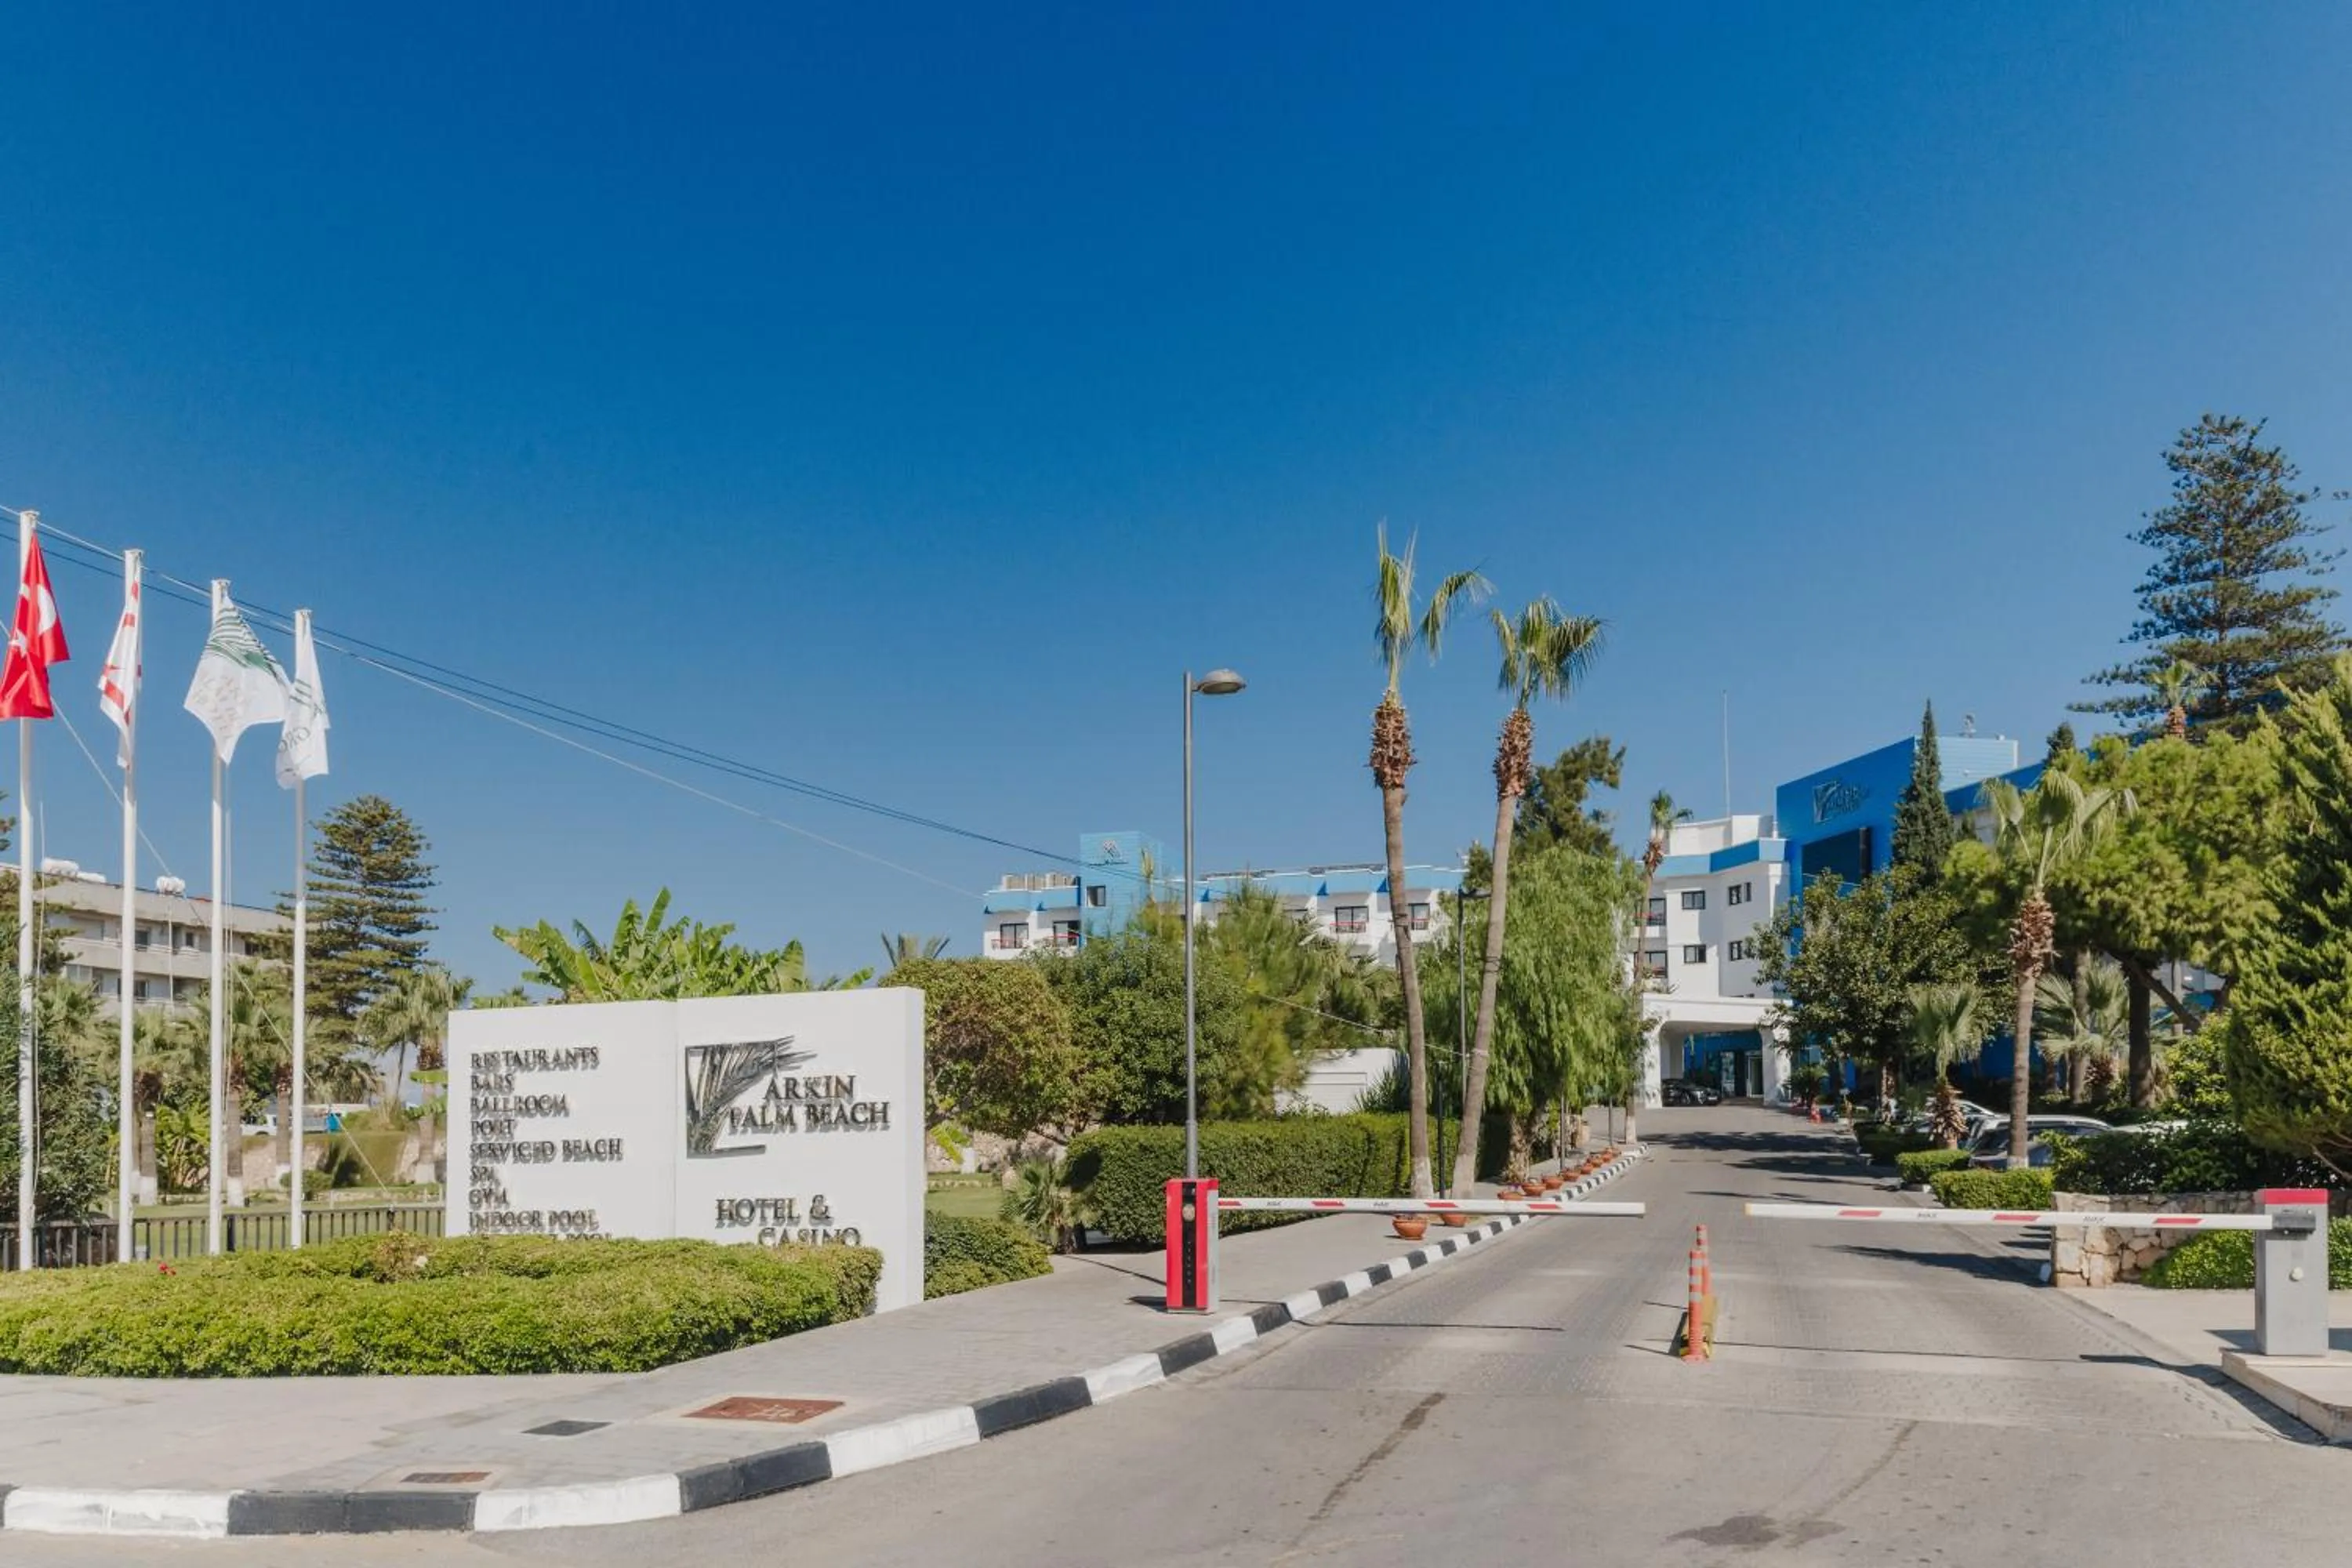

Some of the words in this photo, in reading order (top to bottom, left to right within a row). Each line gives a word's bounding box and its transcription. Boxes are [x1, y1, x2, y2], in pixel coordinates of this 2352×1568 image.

[470, 1047, 599, 1069] RESTAURANTS
[470, 1074, 514, 1092] BARS
[764, 1075, 856, 1102] ARKIN
[470, 1095, 568, 1114] BALLROOM
[730, 1104, 795, 1129] PALM
[805, 1102, 890, 1127] BEACH
[470, 1120, 515, 1138] PORT
[470, 1141, 555, 1161] SERVICED
[561, 1138, 623, 1160] BEACH
[470, 1166, 499, 1184] SPA
[469, 1189, 509, 1207] GYM
[469, 1210, 543, 1230] INDOOR
[548, 1209, 599, 1229] POOL
[715, 1198, 800, 1224] HOTEL
[809, 1194, 833, 1221] &
